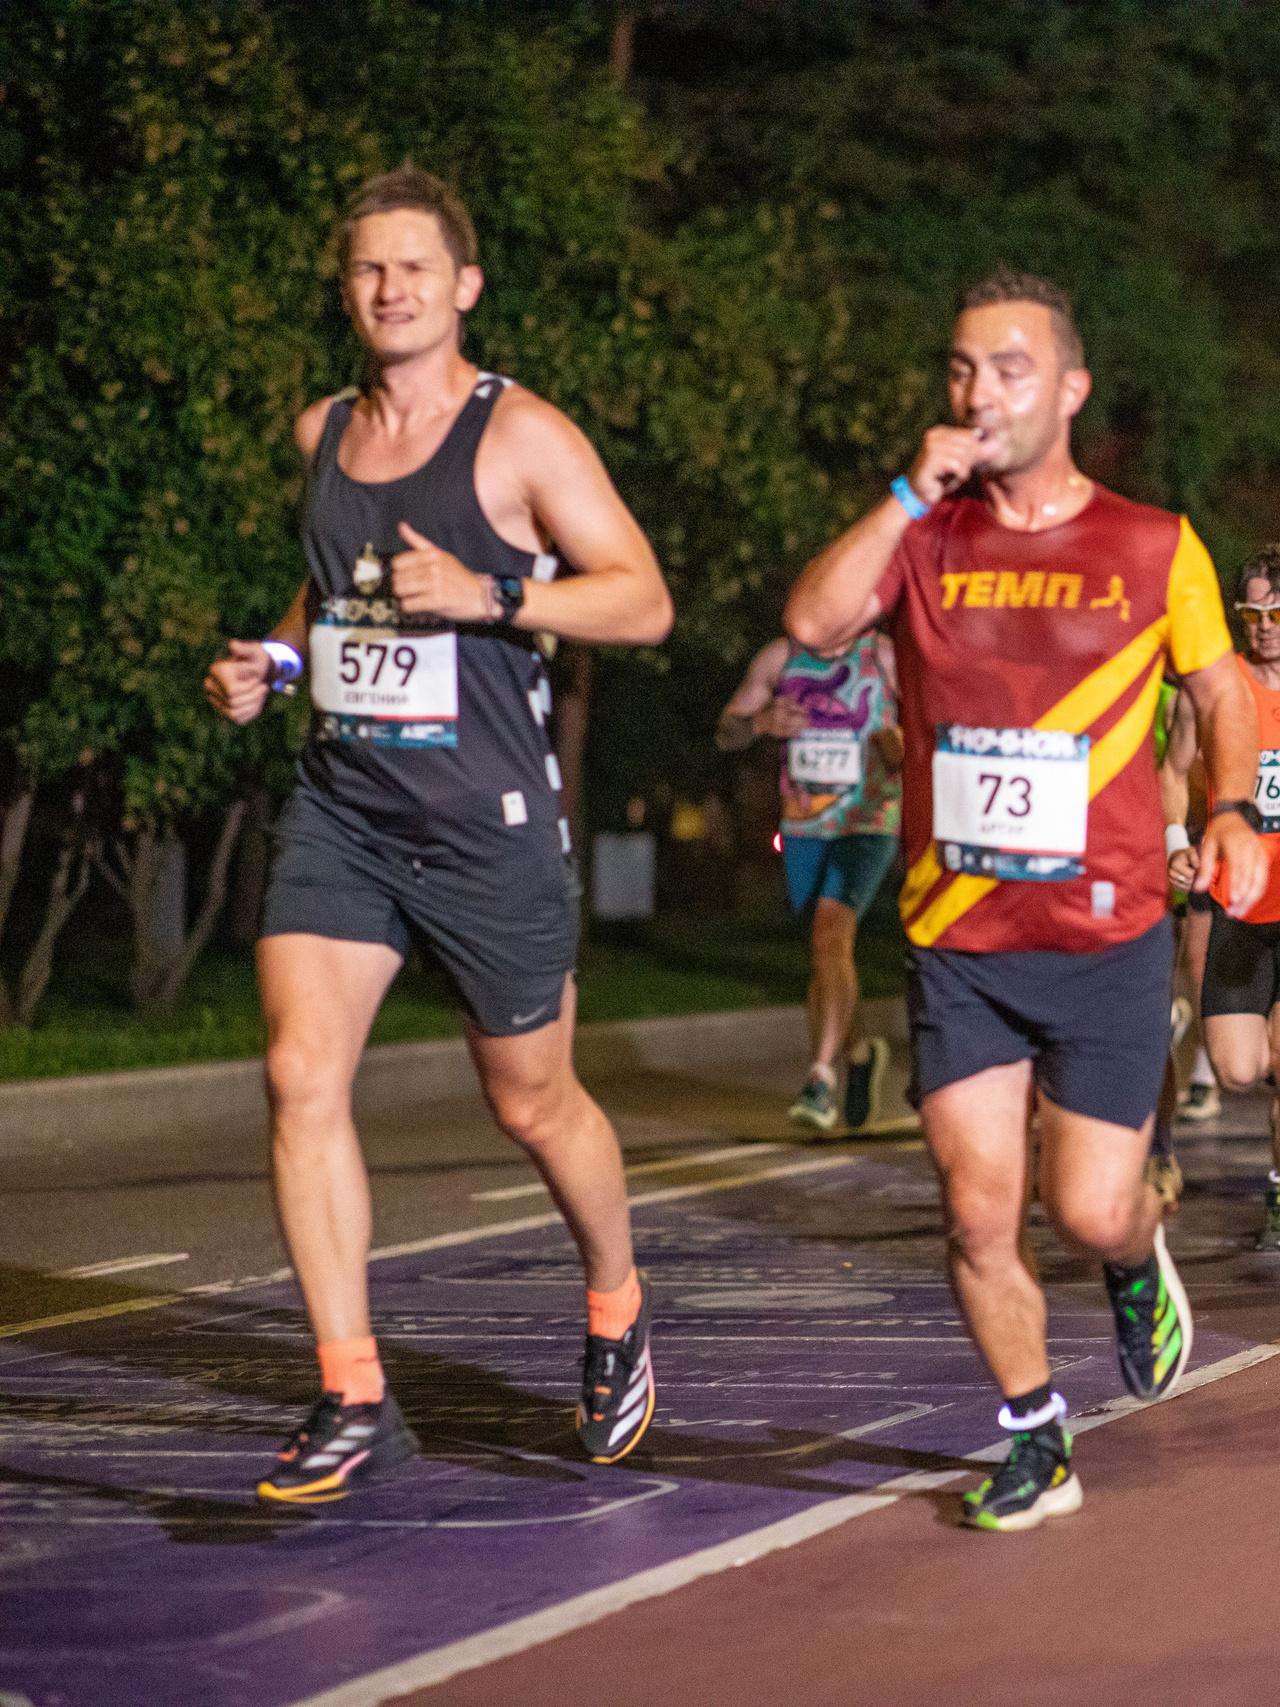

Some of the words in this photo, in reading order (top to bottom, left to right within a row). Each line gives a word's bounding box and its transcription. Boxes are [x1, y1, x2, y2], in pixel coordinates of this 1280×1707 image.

[941, 571, 1084, 609] ТЕМП
[340, 642, 417, 687] 579
[979, 773, 1031, 817] 73
